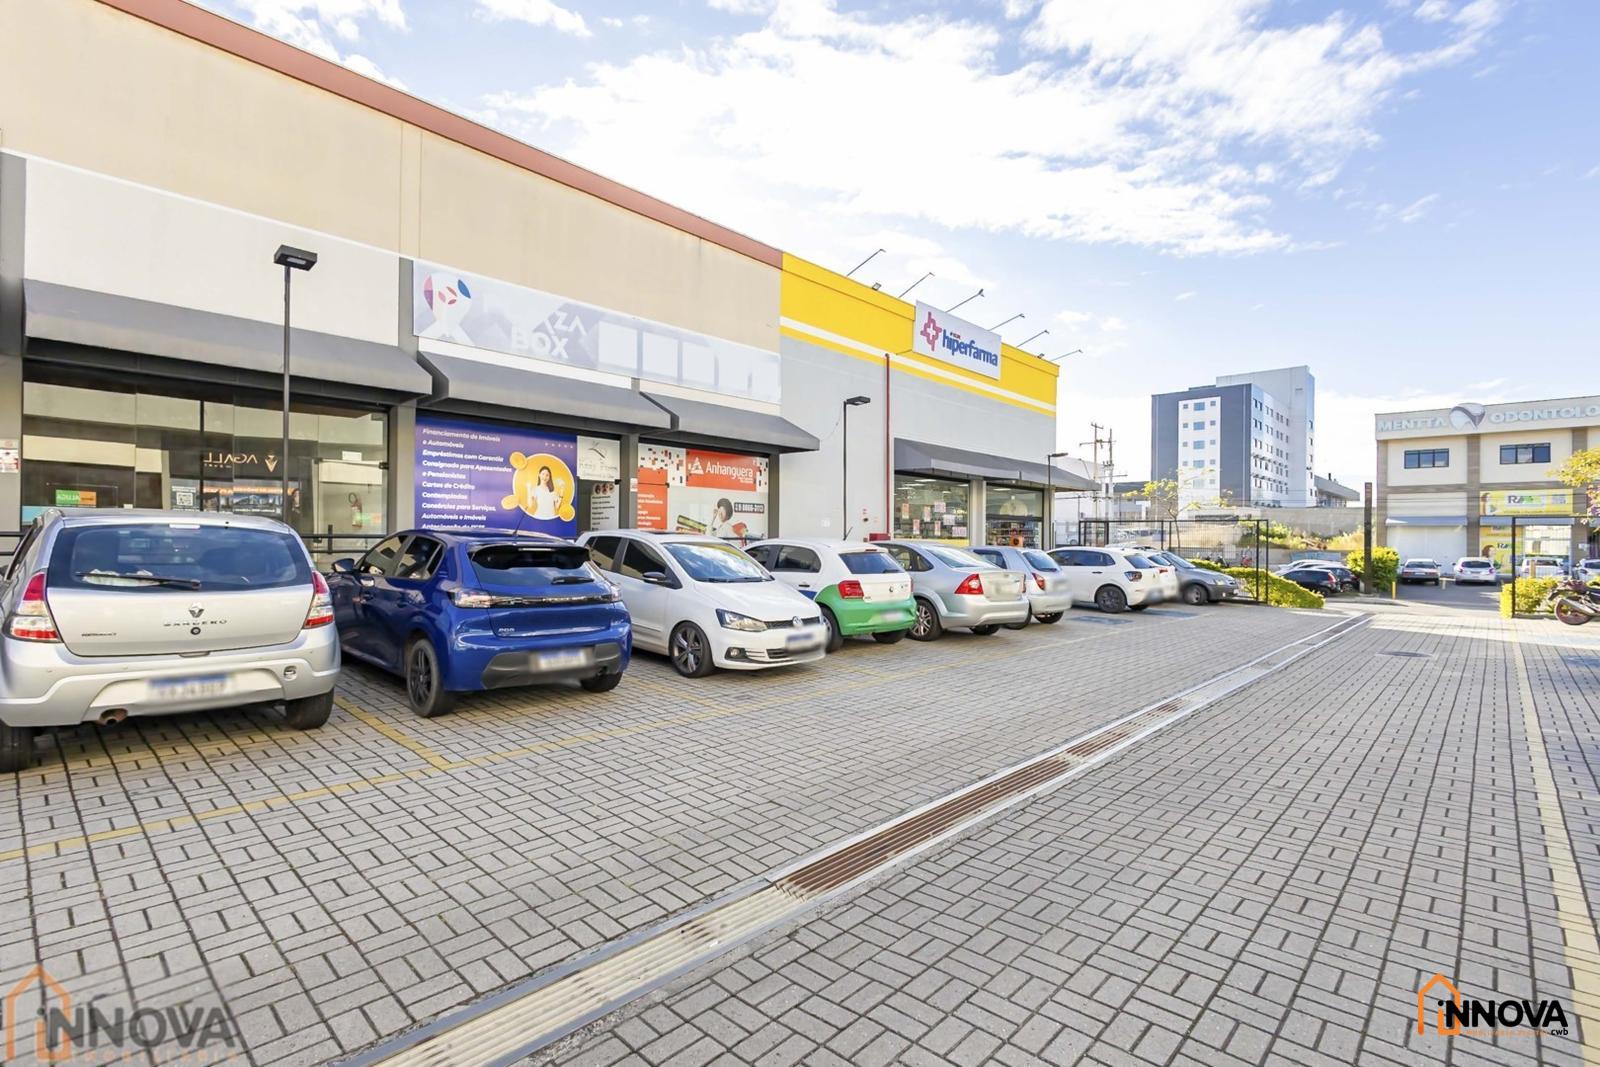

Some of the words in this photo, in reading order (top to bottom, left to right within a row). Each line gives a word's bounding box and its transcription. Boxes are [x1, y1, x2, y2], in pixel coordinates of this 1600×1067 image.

[511, 326, 569, 359] BOX
[942, 329, 998, 367] hiperfarma
[422, 428, 470, 439] Financiamento
[470, 432, 478, 440] de
[422, 449, 463, 459] Empréstimos
[478, 454, 504, 462] Garantia
[422, 460, 460, 469] Consignado
[460, 463, 474, 471] para
[475, 464, 512, 473] Aposentados
[705, 461, 753, 479] Anhanguera
